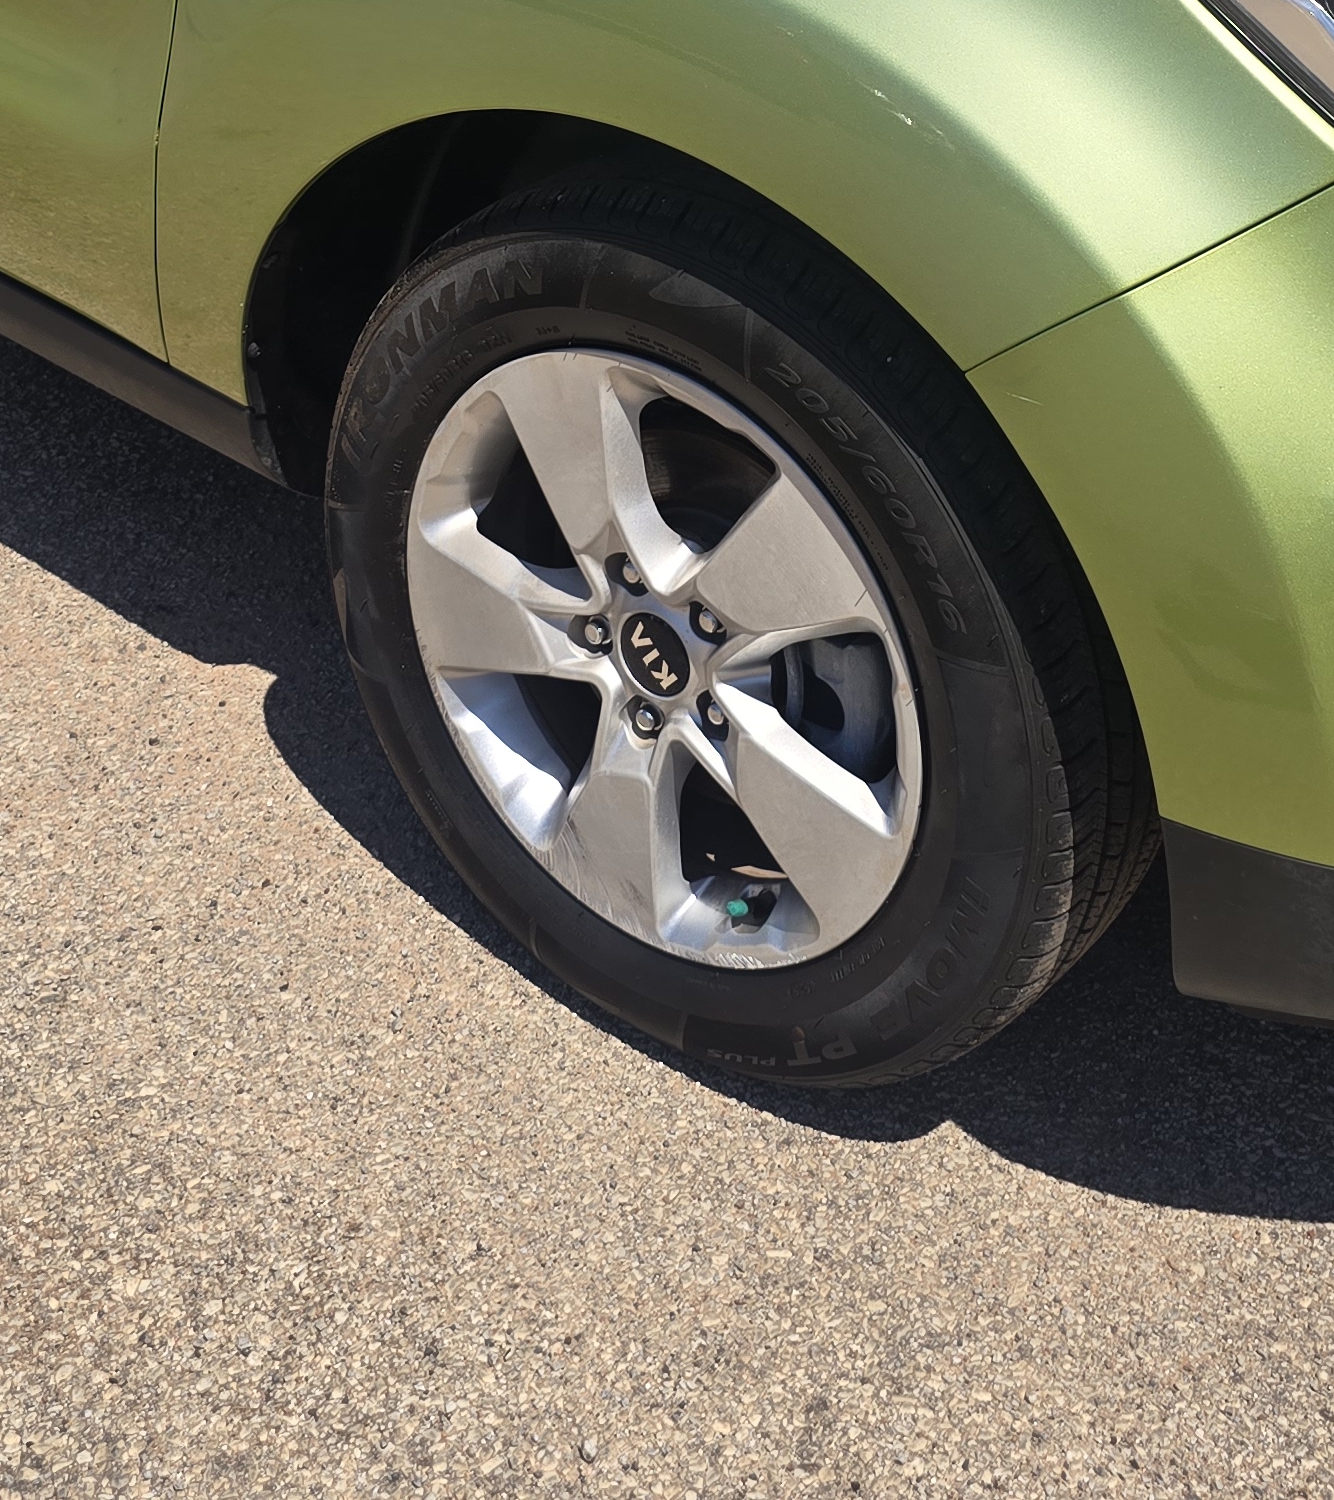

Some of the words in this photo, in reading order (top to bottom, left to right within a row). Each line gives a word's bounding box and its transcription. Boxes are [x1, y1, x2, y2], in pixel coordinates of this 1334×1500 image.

[341, 259, 544, 470] IRONMAN
[764, 361, 968, 636] 205/60R16
[630, 620, 679, 691] KIA
[706, 1047, 777, 1067] PLUS
[785, 1026, 859, 1067] PT
